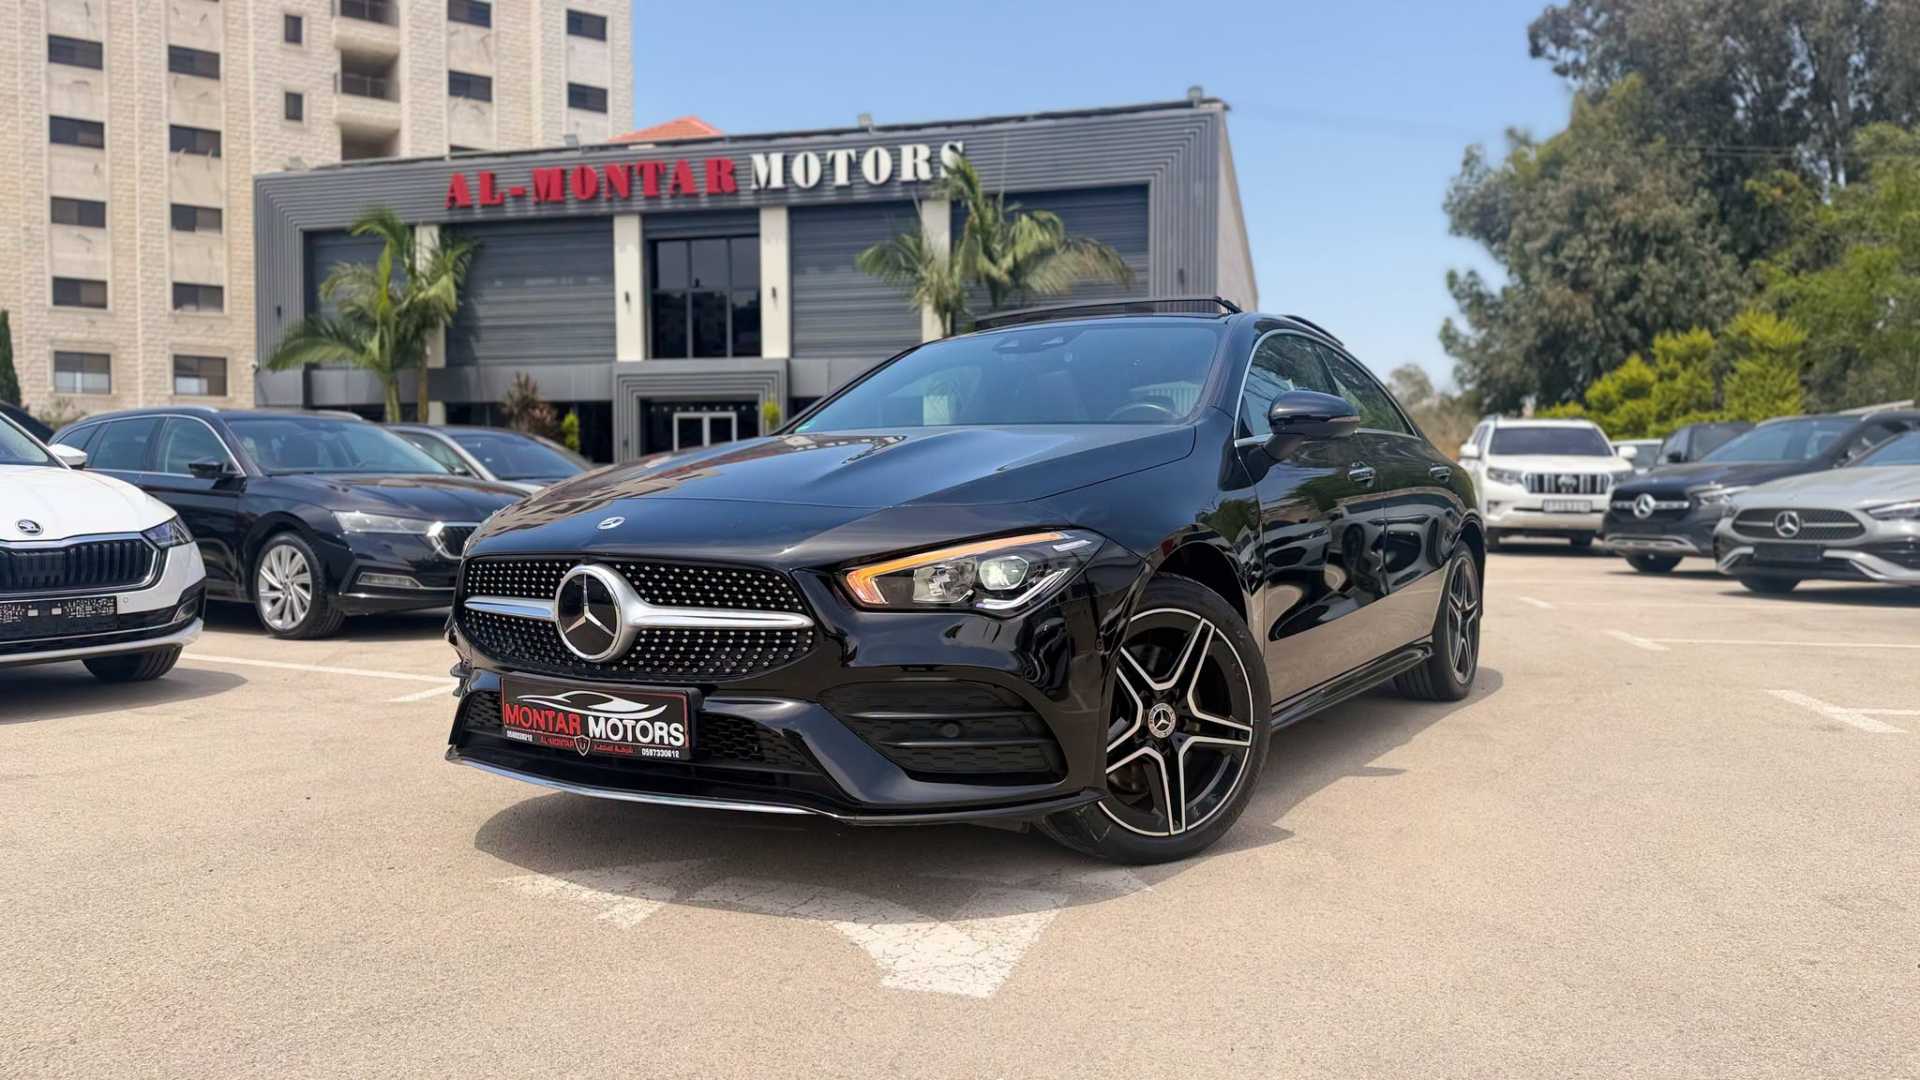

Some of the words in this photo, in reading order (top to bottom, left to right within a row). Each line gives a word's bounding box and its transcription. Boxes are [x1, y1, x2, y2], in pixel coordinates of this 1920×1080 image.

[445, 157, 737, 209] AL-MONTAR
[751, 141, 965, 190] MOTORS
[504, 703, 581, 735] MONTAR
[588, 715, 685, 747] MOTORS
